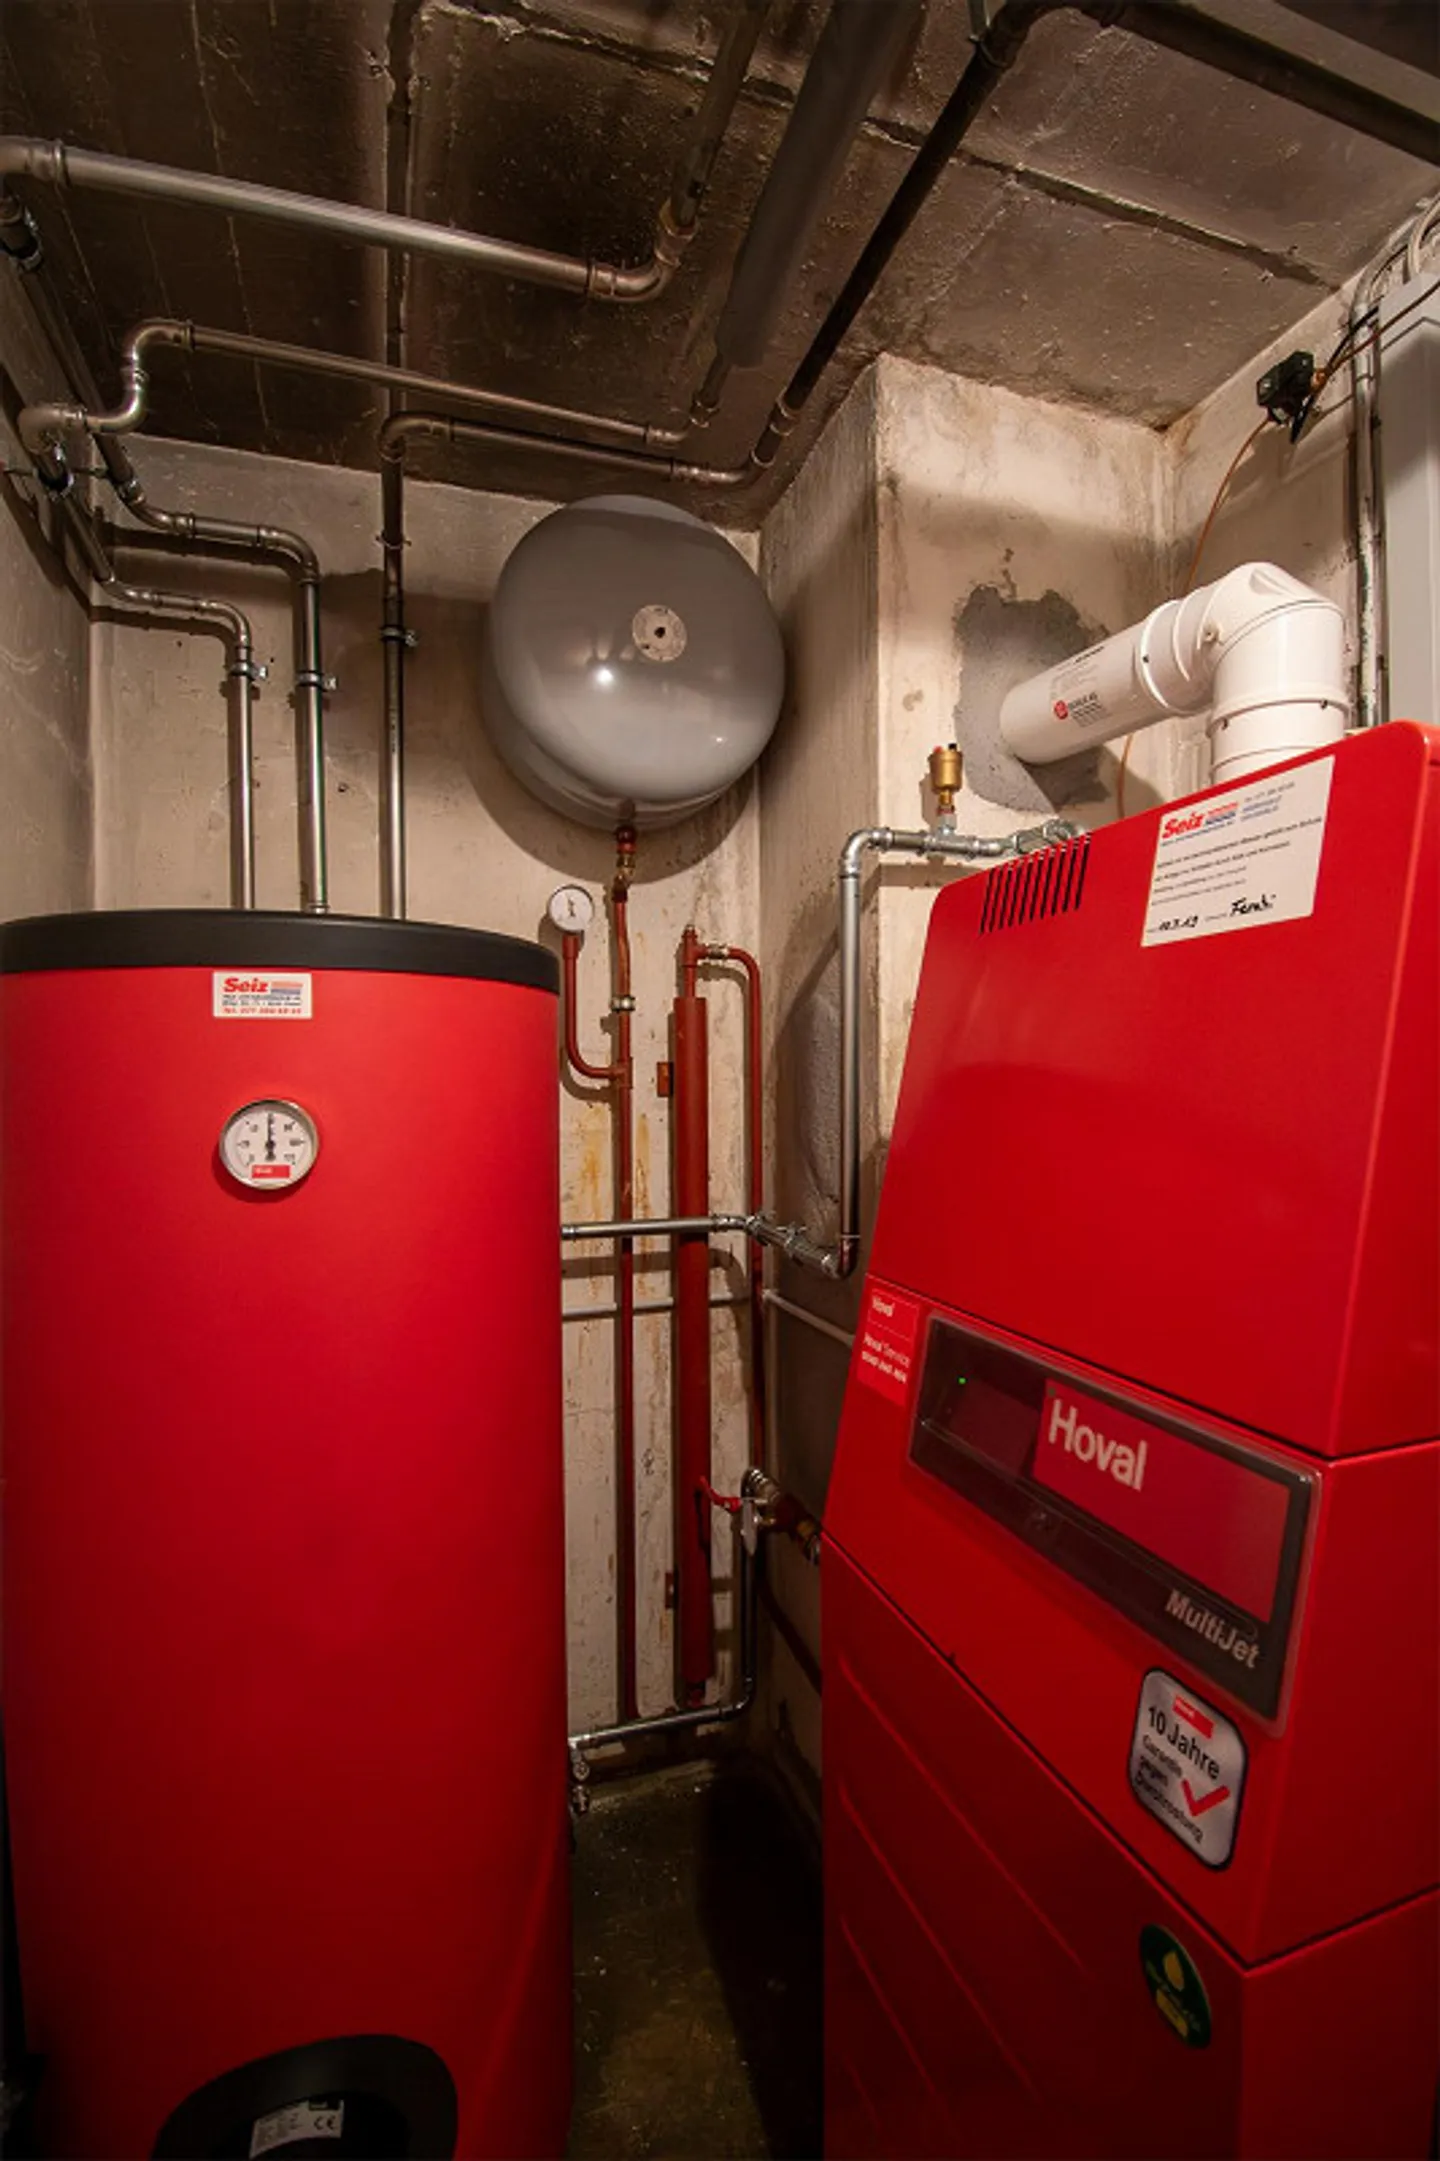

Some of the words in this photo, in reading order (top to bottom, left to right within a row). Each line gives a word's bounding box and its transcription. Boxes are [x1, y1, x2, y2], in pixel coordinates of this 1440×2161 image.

[1162, 811, 1206, 839] Seiz
[223, 977, 269, 993] Seiz
[1048, 1398, 1149, 1492] Hoval
[1164, 1588, 1260, 1668] MultiJet
[1147, 1705, 1167, 1735] 10
[1167, 1723, 1221, 1781] Jahre
